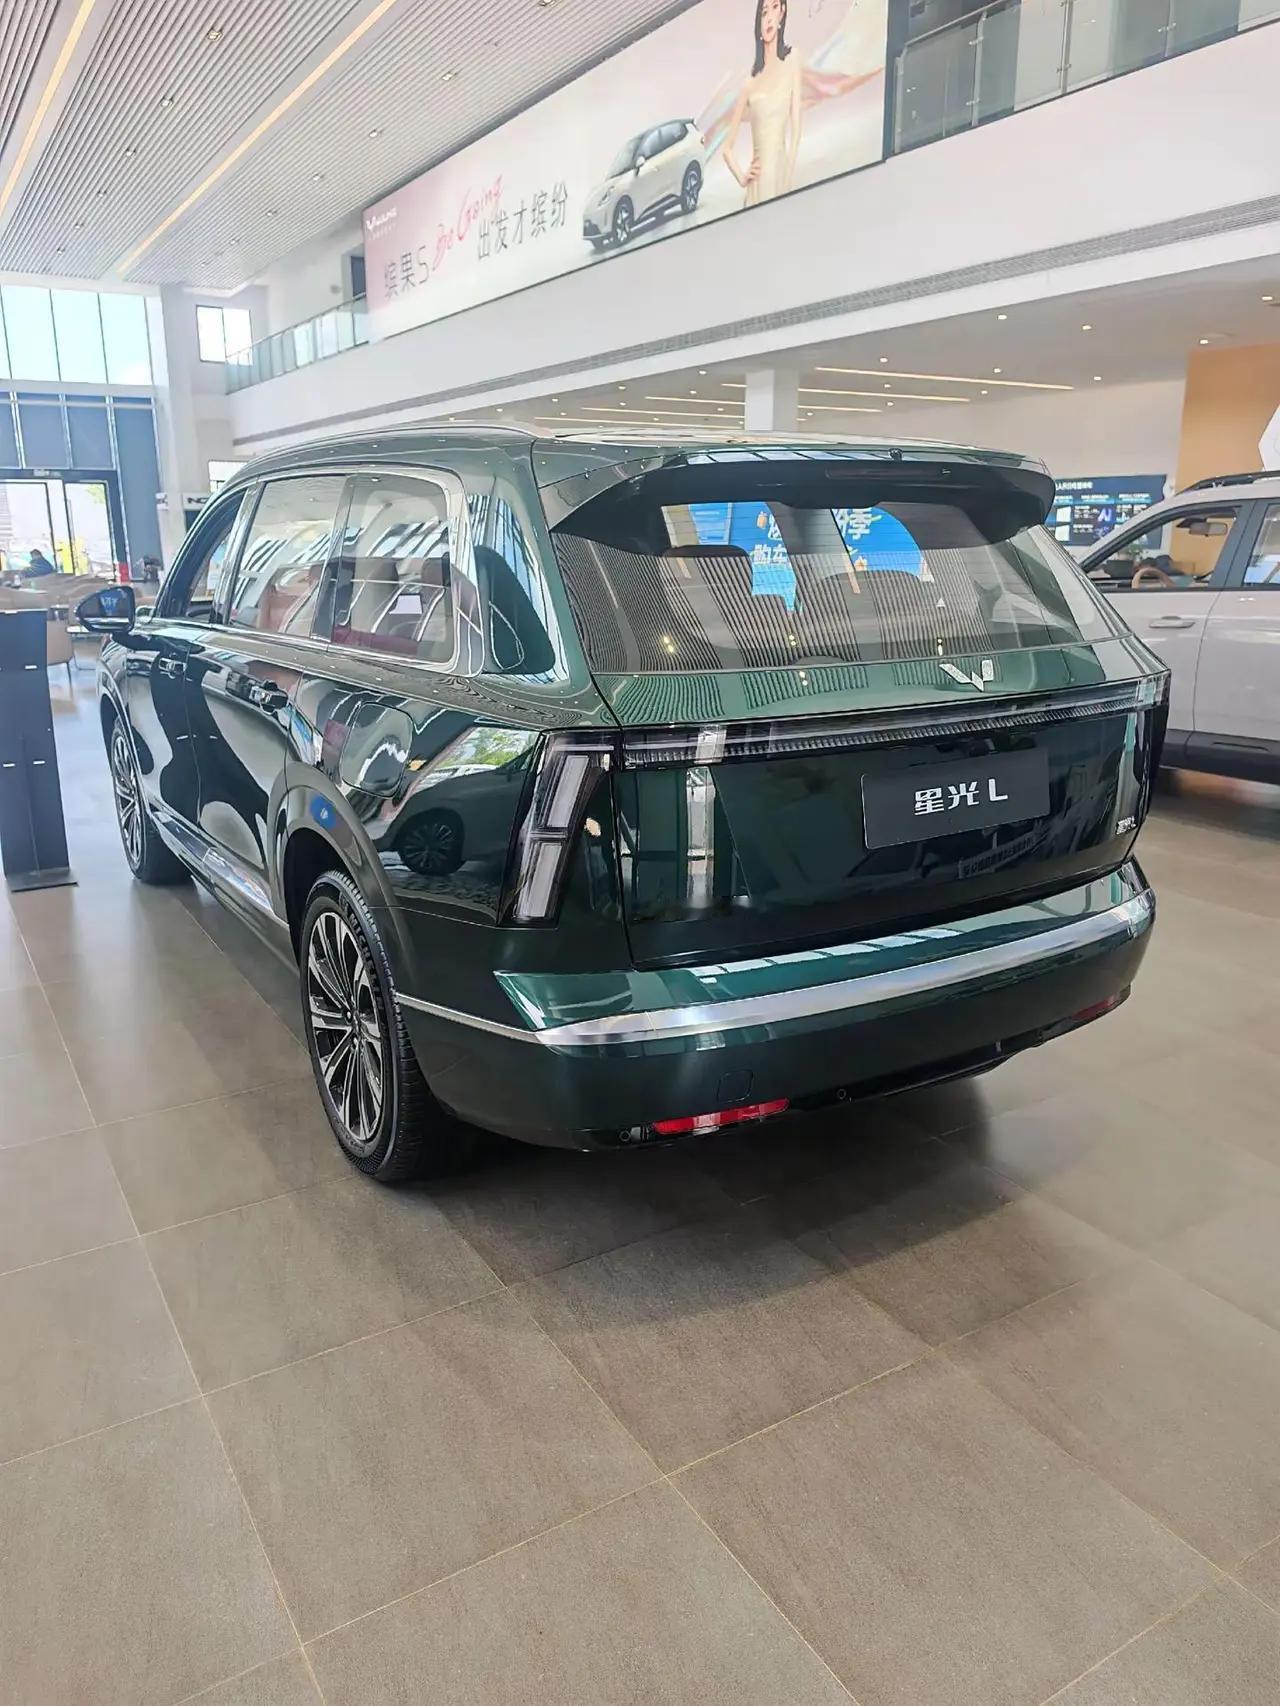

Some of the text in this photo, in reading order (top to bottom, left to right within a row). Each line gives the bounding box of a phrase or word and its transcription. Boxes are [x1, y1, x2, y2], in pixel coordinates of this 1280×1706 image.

[478, 181, 568, 261] 出发才缤纷
